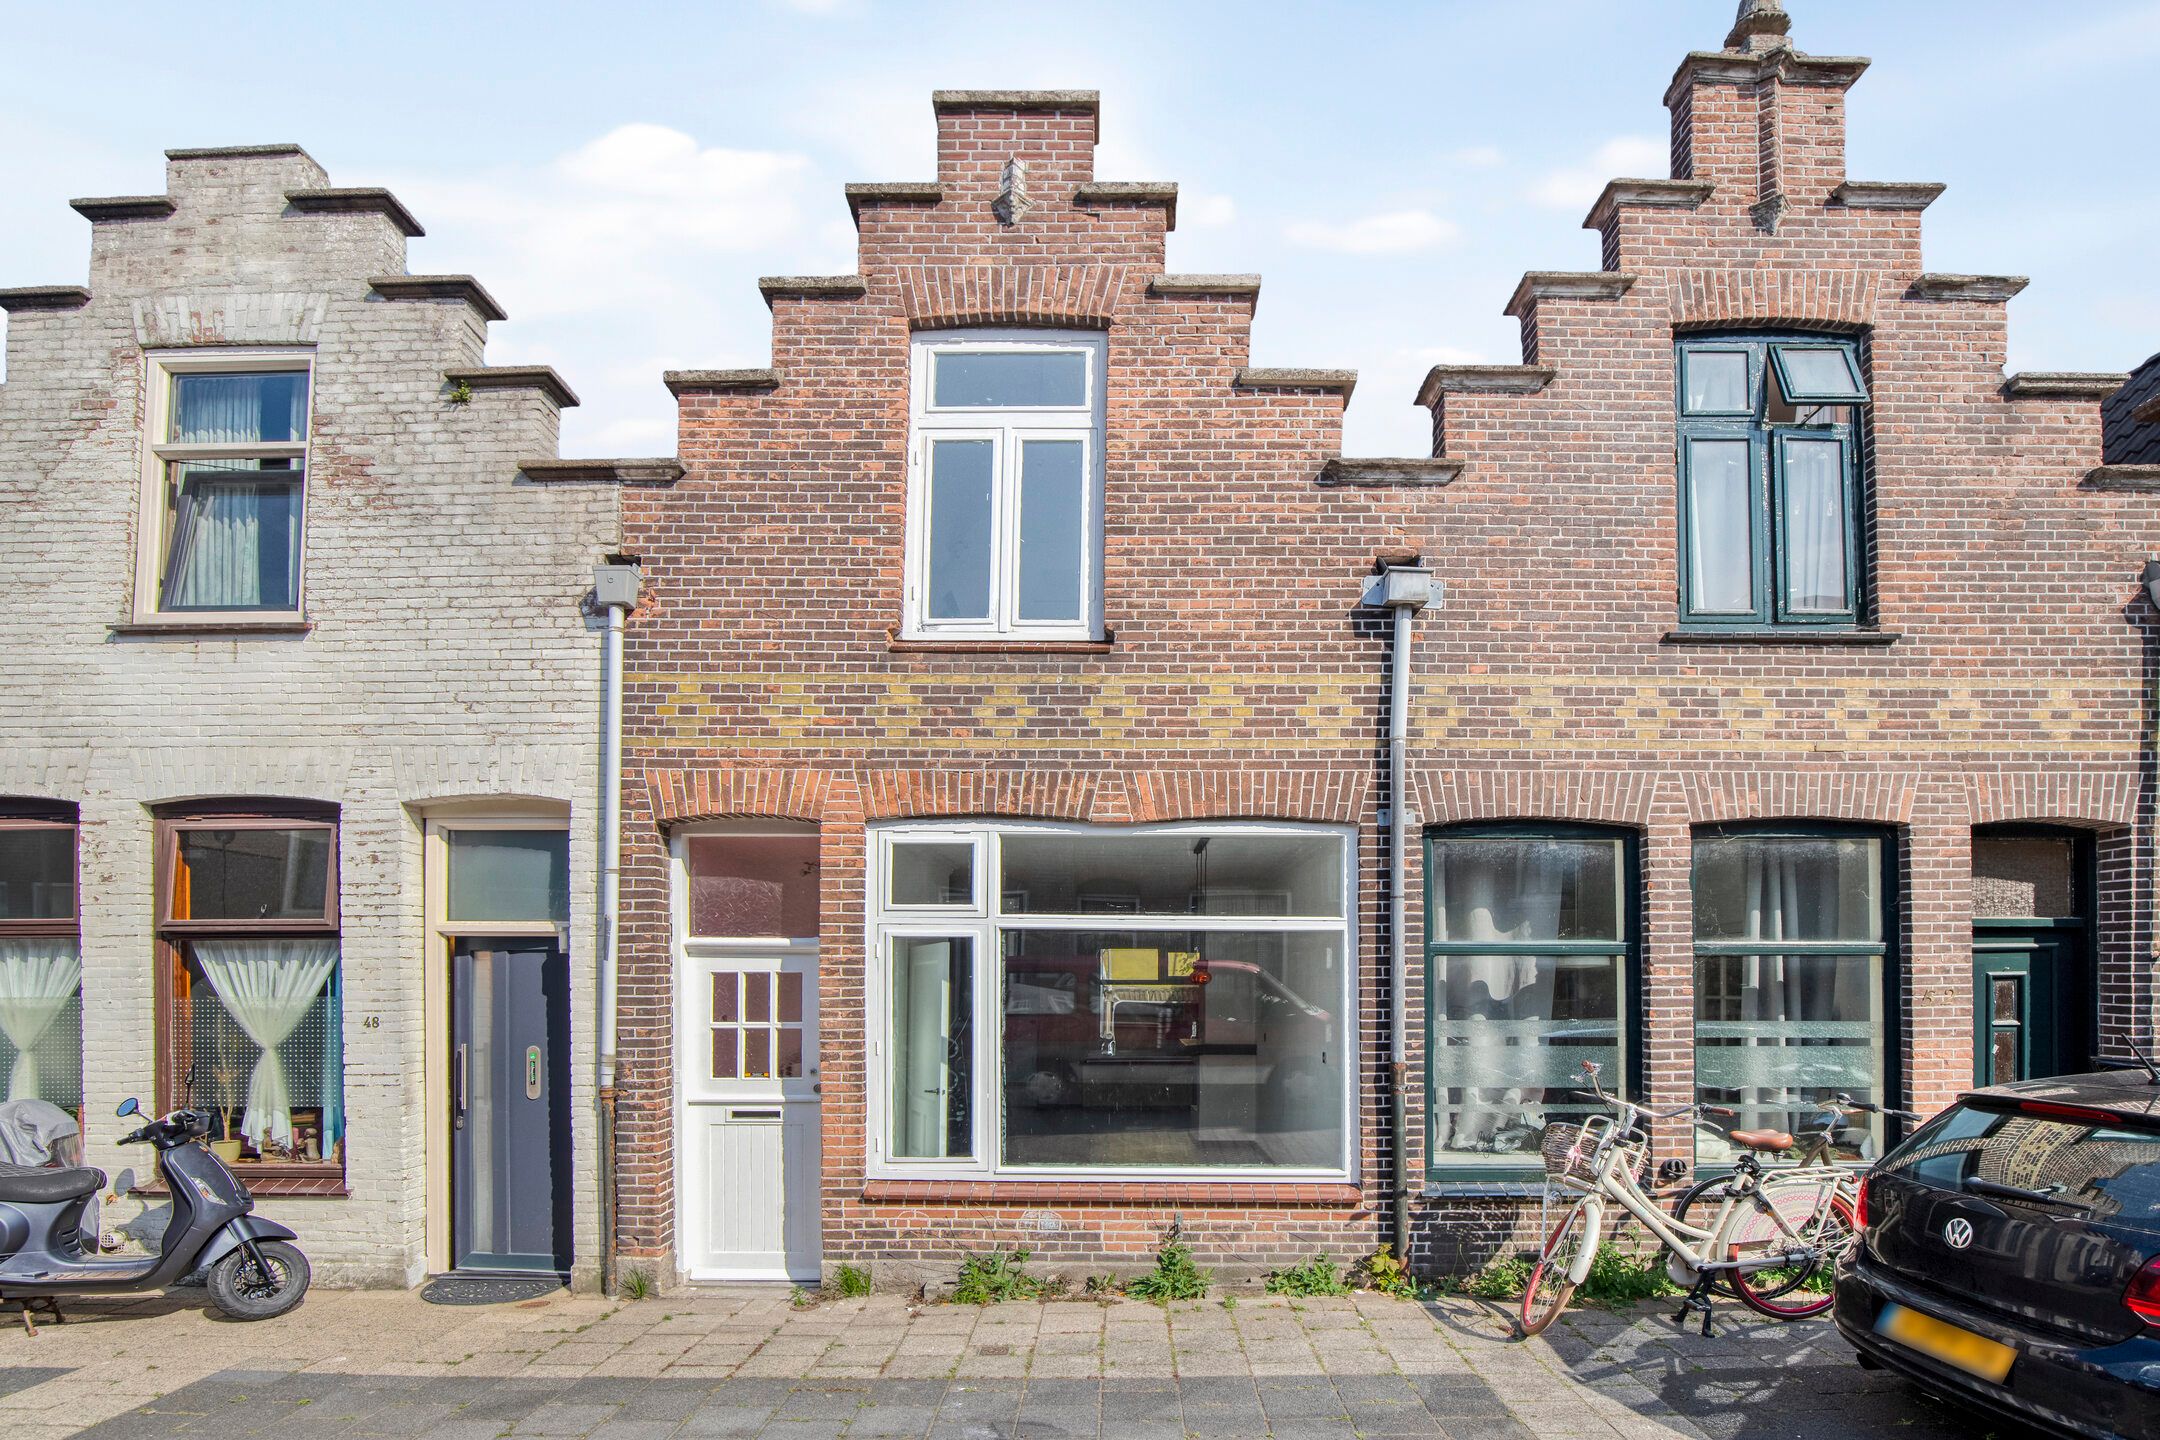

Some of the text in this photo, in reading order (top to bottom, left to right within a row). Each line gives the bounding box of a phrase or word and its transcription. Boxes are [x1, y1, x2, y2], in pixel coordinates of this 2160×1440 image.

[1920, 989, 1955, 1007] 52
[363, 1016, 380, 1028] 48
[1945, 1217, 1973, 1249] VW
